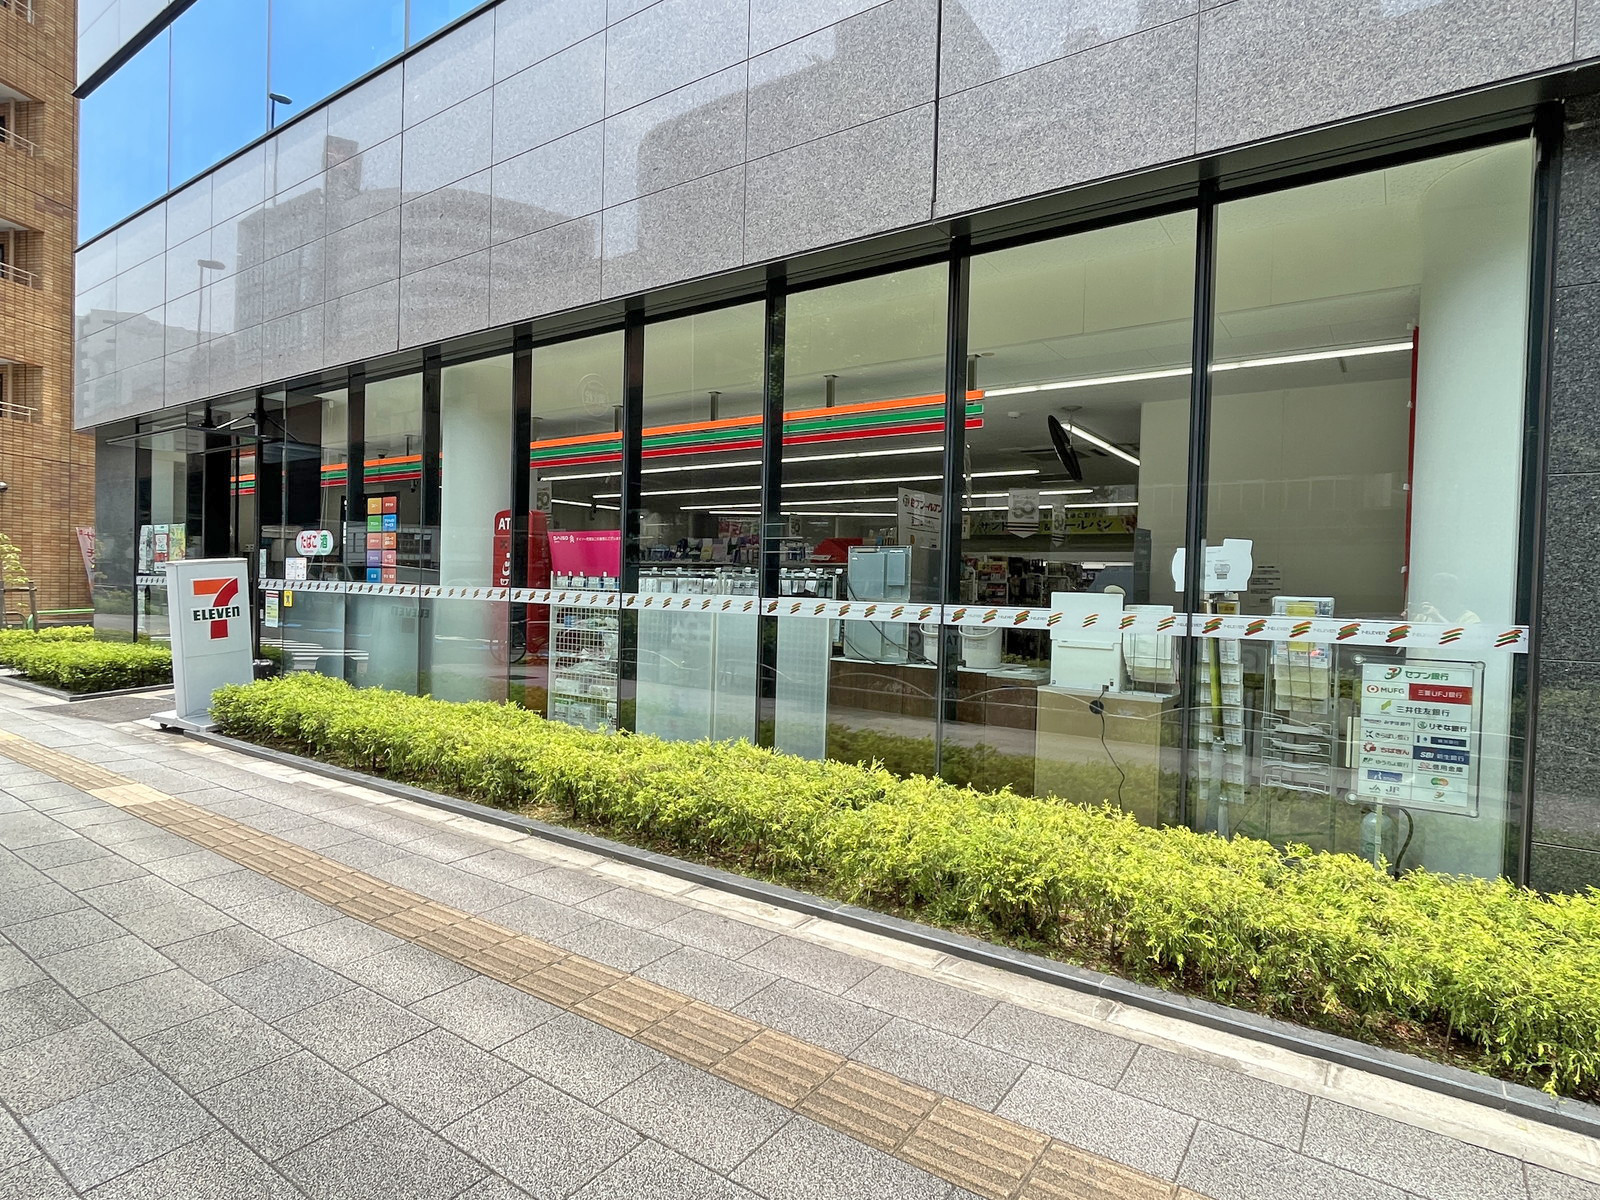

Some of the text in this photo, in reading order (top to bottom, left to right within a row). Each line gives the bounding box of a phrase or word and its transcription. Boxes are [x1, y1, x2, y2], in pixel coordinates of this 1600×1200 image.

[498, 518, 511, 530] AT
[301, 533, 317, 548] たばこ
[1405, 670, 1449, 681] セブン銀行
[1418, 689, 1463, 699] 三菱UFJ銀行
[1396, 705, 1450, 717] 三井住友銀行
[1429, 723, 1467, 732] りそな銀行
